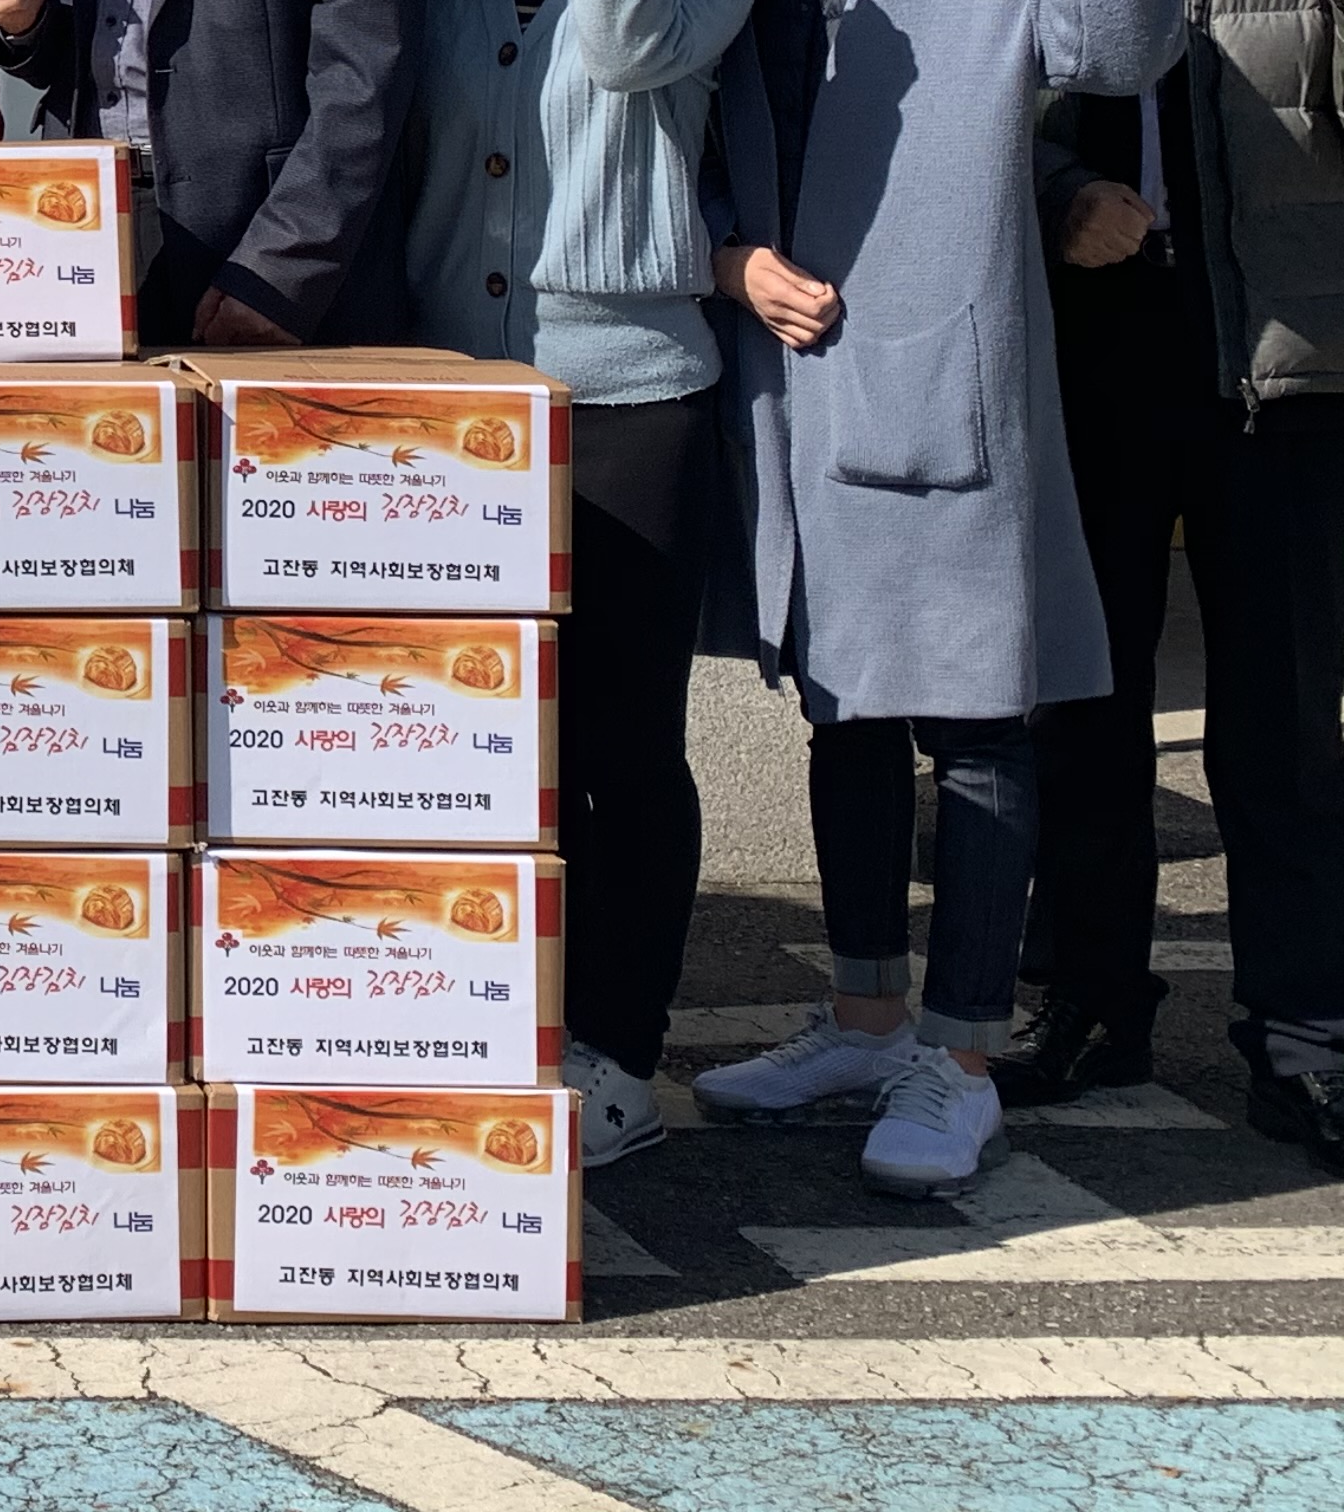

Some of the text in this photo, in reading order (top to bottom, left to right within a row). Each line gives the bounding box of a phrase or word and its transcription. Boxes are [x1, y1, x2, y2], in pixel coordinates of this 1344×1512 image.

[58, 266, 94, 284] 나눔
[266, 470, 445, 487] 이웃과 함께하는 따뜻한 겨울나기
[242, 493, 522, 525] 2020 사랑의 김장김치 나눔
[263, 559, 499, 581] 고잔동 지역사회보장협의체
[16, 942, 62, 956] 겨울나기
[101, 977, 140, 998] 나눔
[284, 1172, 465, 1190] 이웃과 함께하는 따뜻한 겨울나기
[258, 1200, 542, 1233] 2020 사랑의 김장김치 나눔
[279, 1266, 519, 1291] 고잔동 지역사회보장협의체
